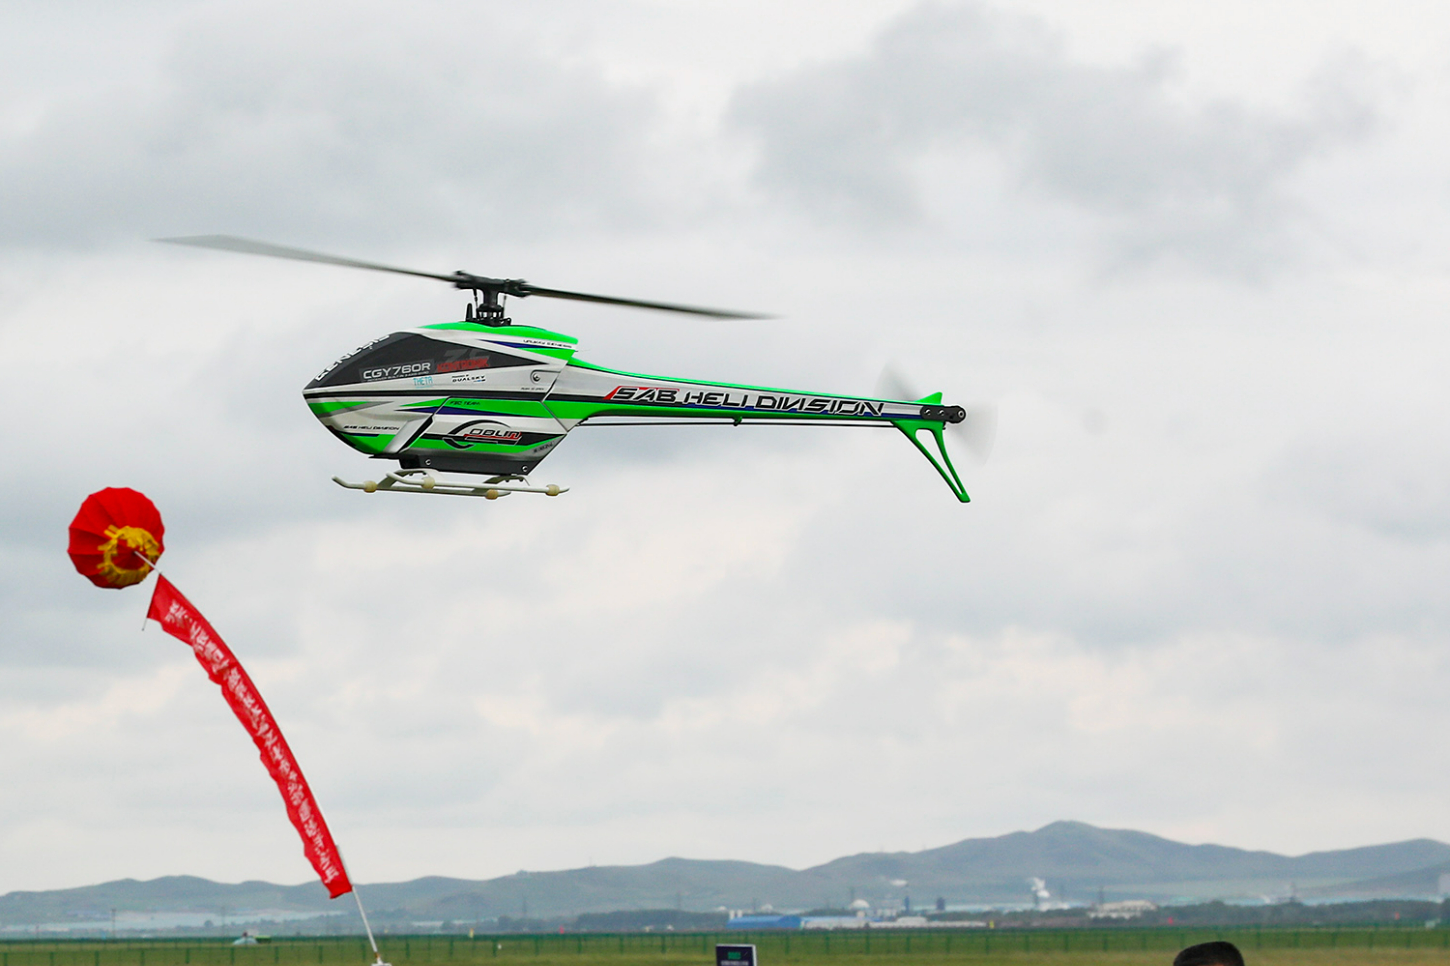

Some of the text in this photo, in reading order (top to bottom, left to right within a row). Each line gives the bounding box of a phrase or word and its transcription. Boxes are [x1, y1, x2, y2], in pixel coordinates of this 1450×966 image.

[363, 362, 431, 380] CGY760R
[612, 387, 885, 416] SAB HELI DIVISION
